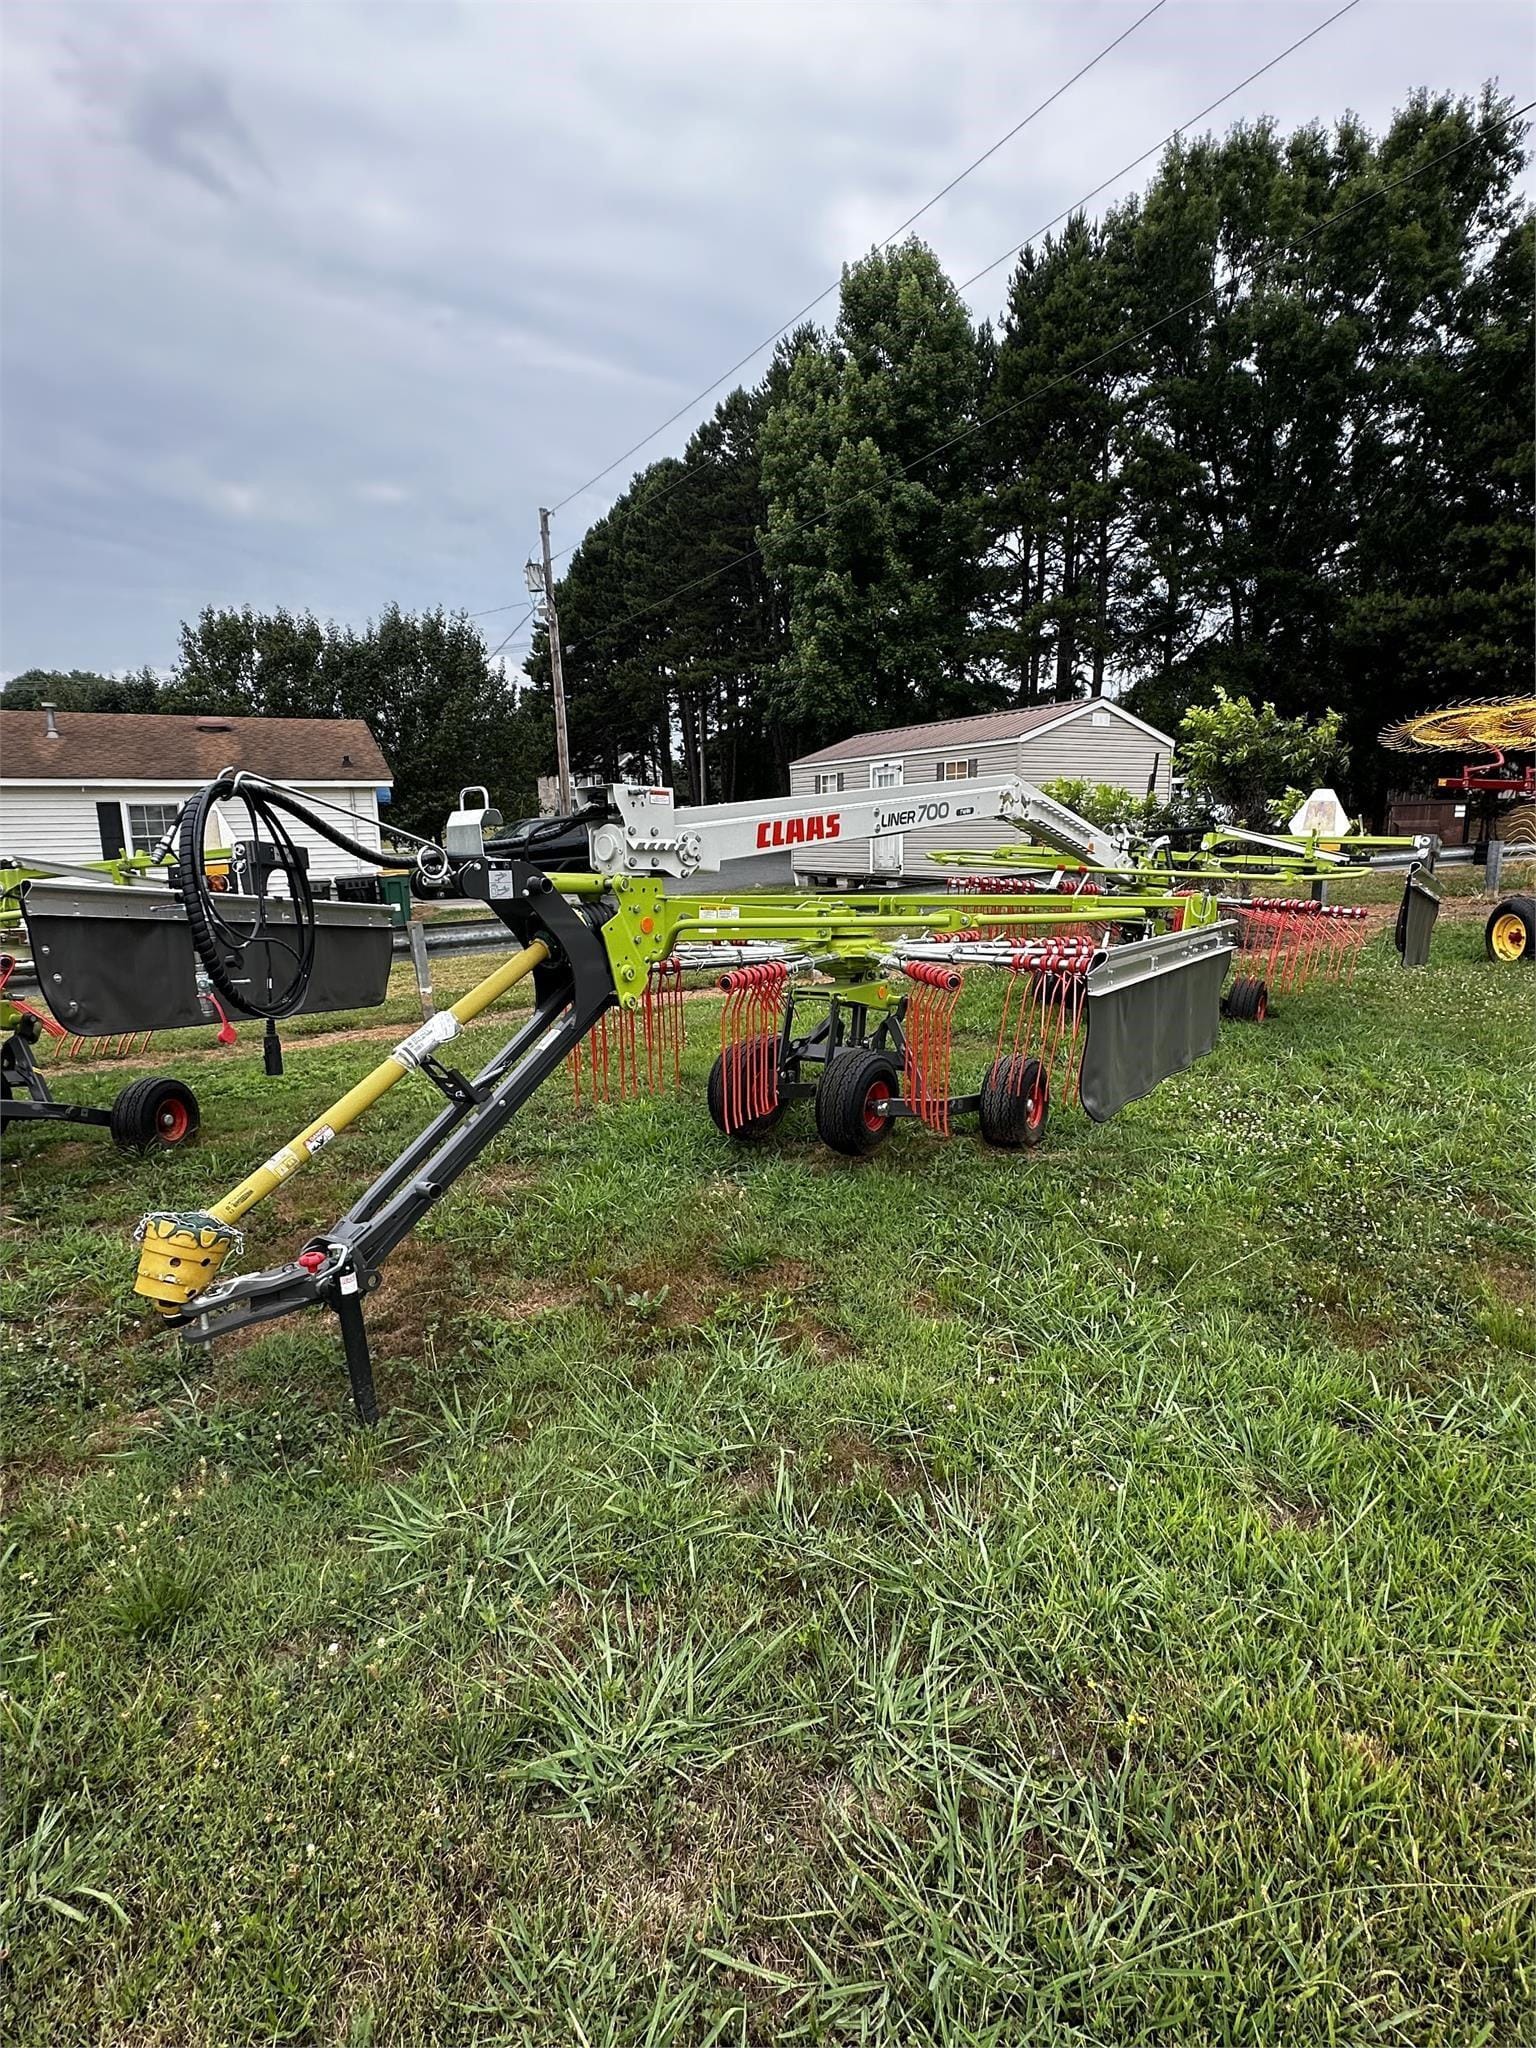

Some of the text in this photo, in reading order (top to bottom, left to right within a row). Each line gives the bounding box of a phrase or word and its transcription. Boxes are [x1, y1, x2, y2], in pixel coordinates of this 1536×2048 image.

[881, 810, 916, 828] LINER
[917, 801, 950, 823] 700
[756, 813, 841, 849] CLAAS
